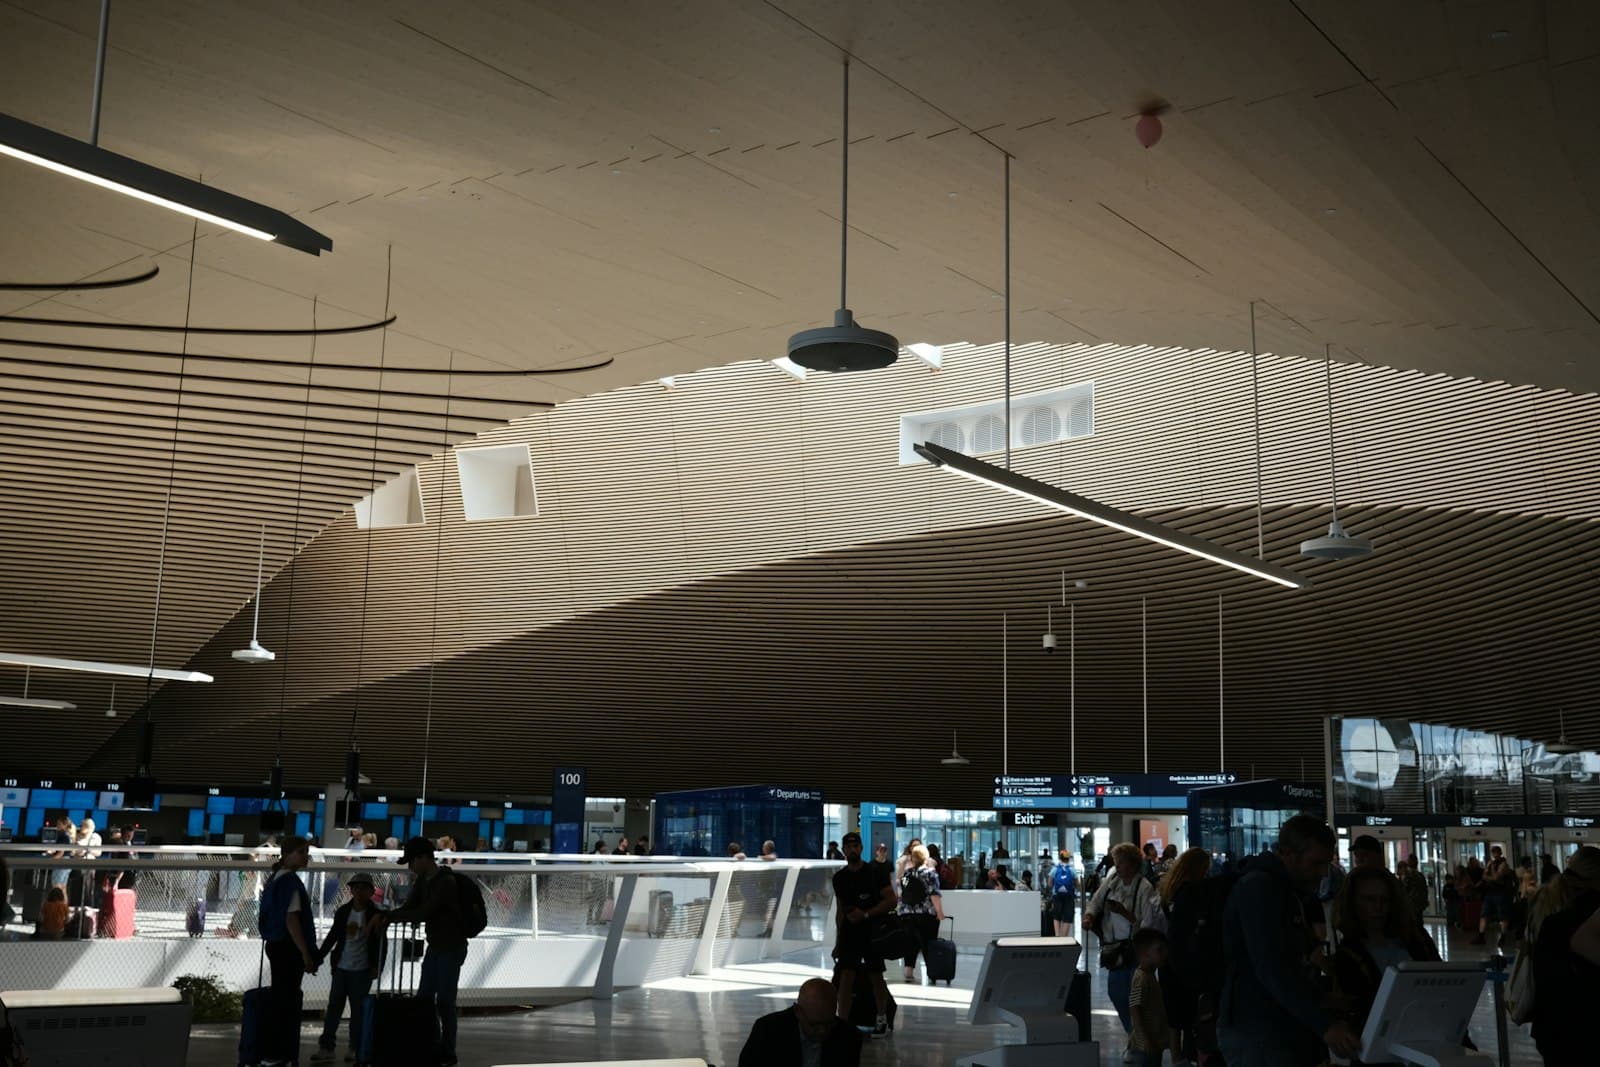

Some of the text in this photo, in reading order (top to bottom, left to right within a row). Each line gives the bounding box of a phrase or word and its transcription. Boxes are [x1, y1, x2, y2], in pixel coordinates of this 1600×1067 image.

[4, 779, 18, 787] 113
[560, 773, 581, 785] 100
[777, 789, 810, 800] Departures
[1288, 784, 1314, 797] Departures
[1015, 813, 1034, 825] Exit
